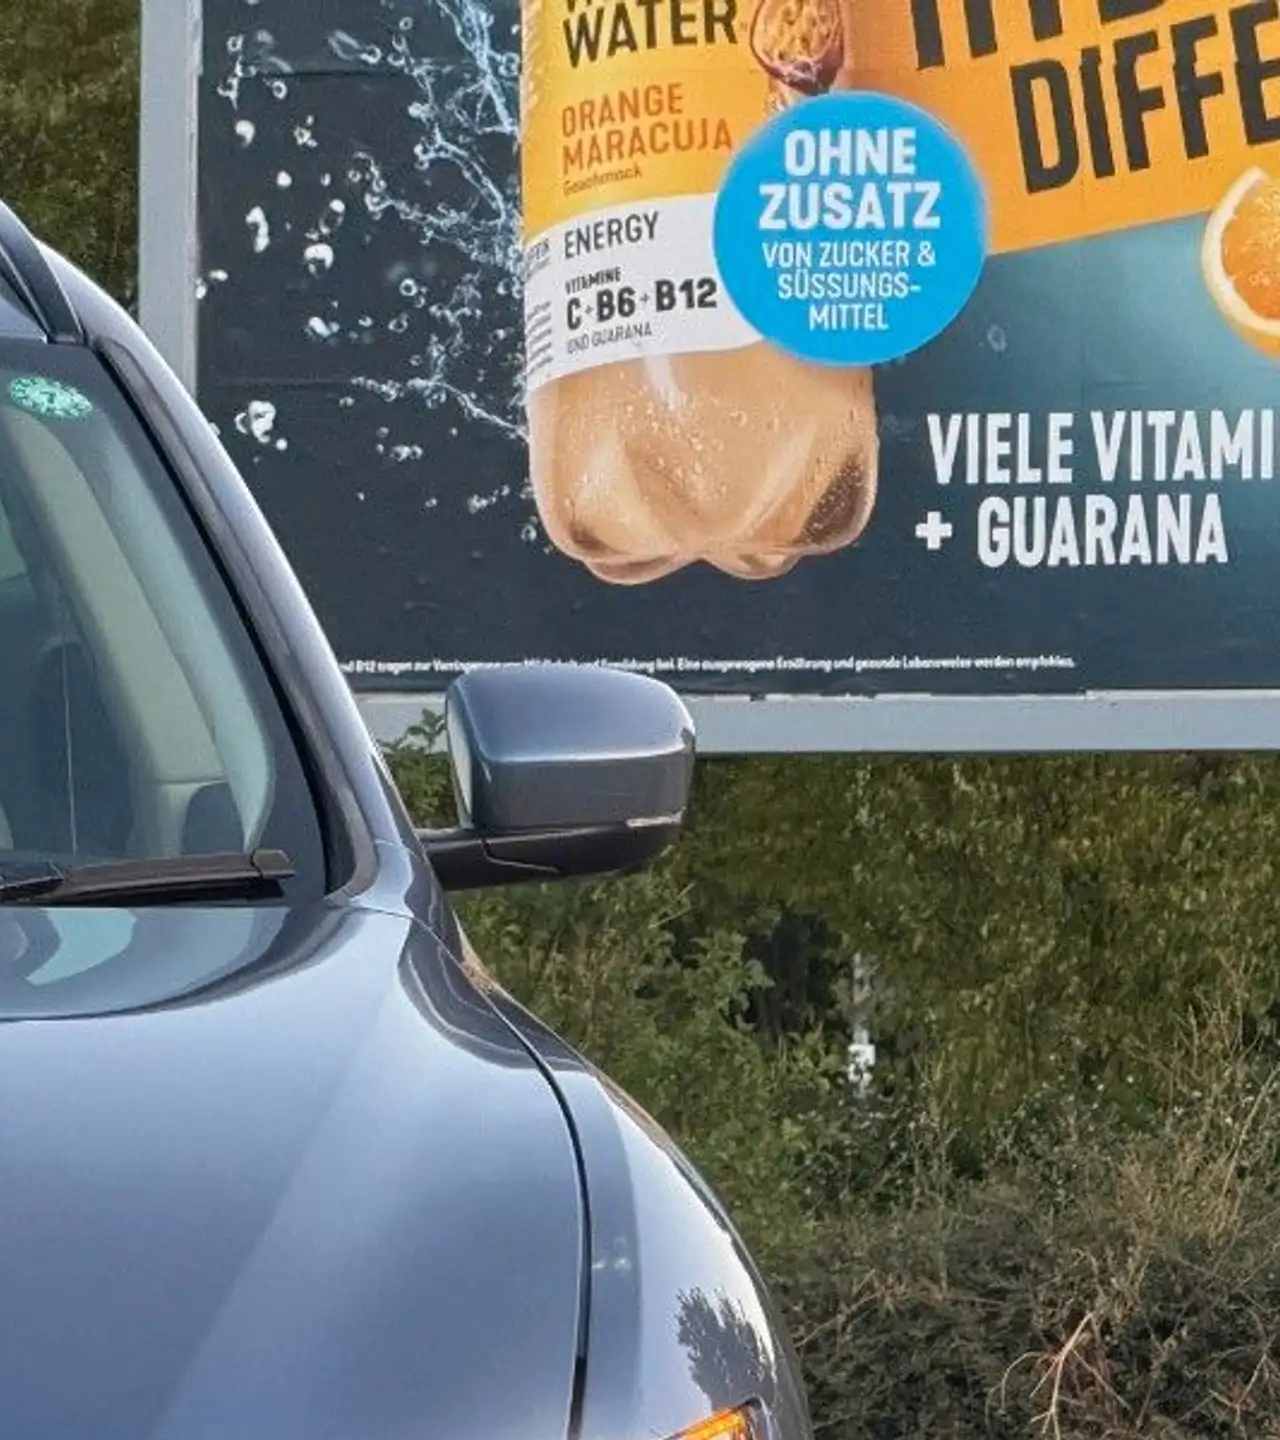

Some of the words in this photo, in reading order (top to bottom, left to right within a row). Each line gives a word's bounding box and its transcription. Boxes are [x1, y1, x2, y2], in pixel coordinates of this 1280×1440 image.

[563, 0, 738, 68] WATER
[562, 83, 683, 138] ORANGE
[1009, 0, 1280, 195] DIFFE
[562, 118, 732, 175] MARACUJA
[784, 127, 917, 176] OHNE
[758, 182, 941, 230] ZUSATZ
[564, 211, 659, 259] ENERGY
[761, 242, 812, 268] VON
[819, 241, 910, 268] ZUCKER
[917, 241, 935, 267] &
[565, 267, 622, 294] VITAMINE
[777, 267, 922, 299] SÜSSUNGS-
[591, 322, 653, 350] GUARANA
[808, 303, 889, 331] MITTEL
[926, 412, 1073, 484] VIELE
[1090, 409, 1274, 482] VITAMI
[915, 510, 953, 550] +
[977, 493, 1229, 568] GUARANA
